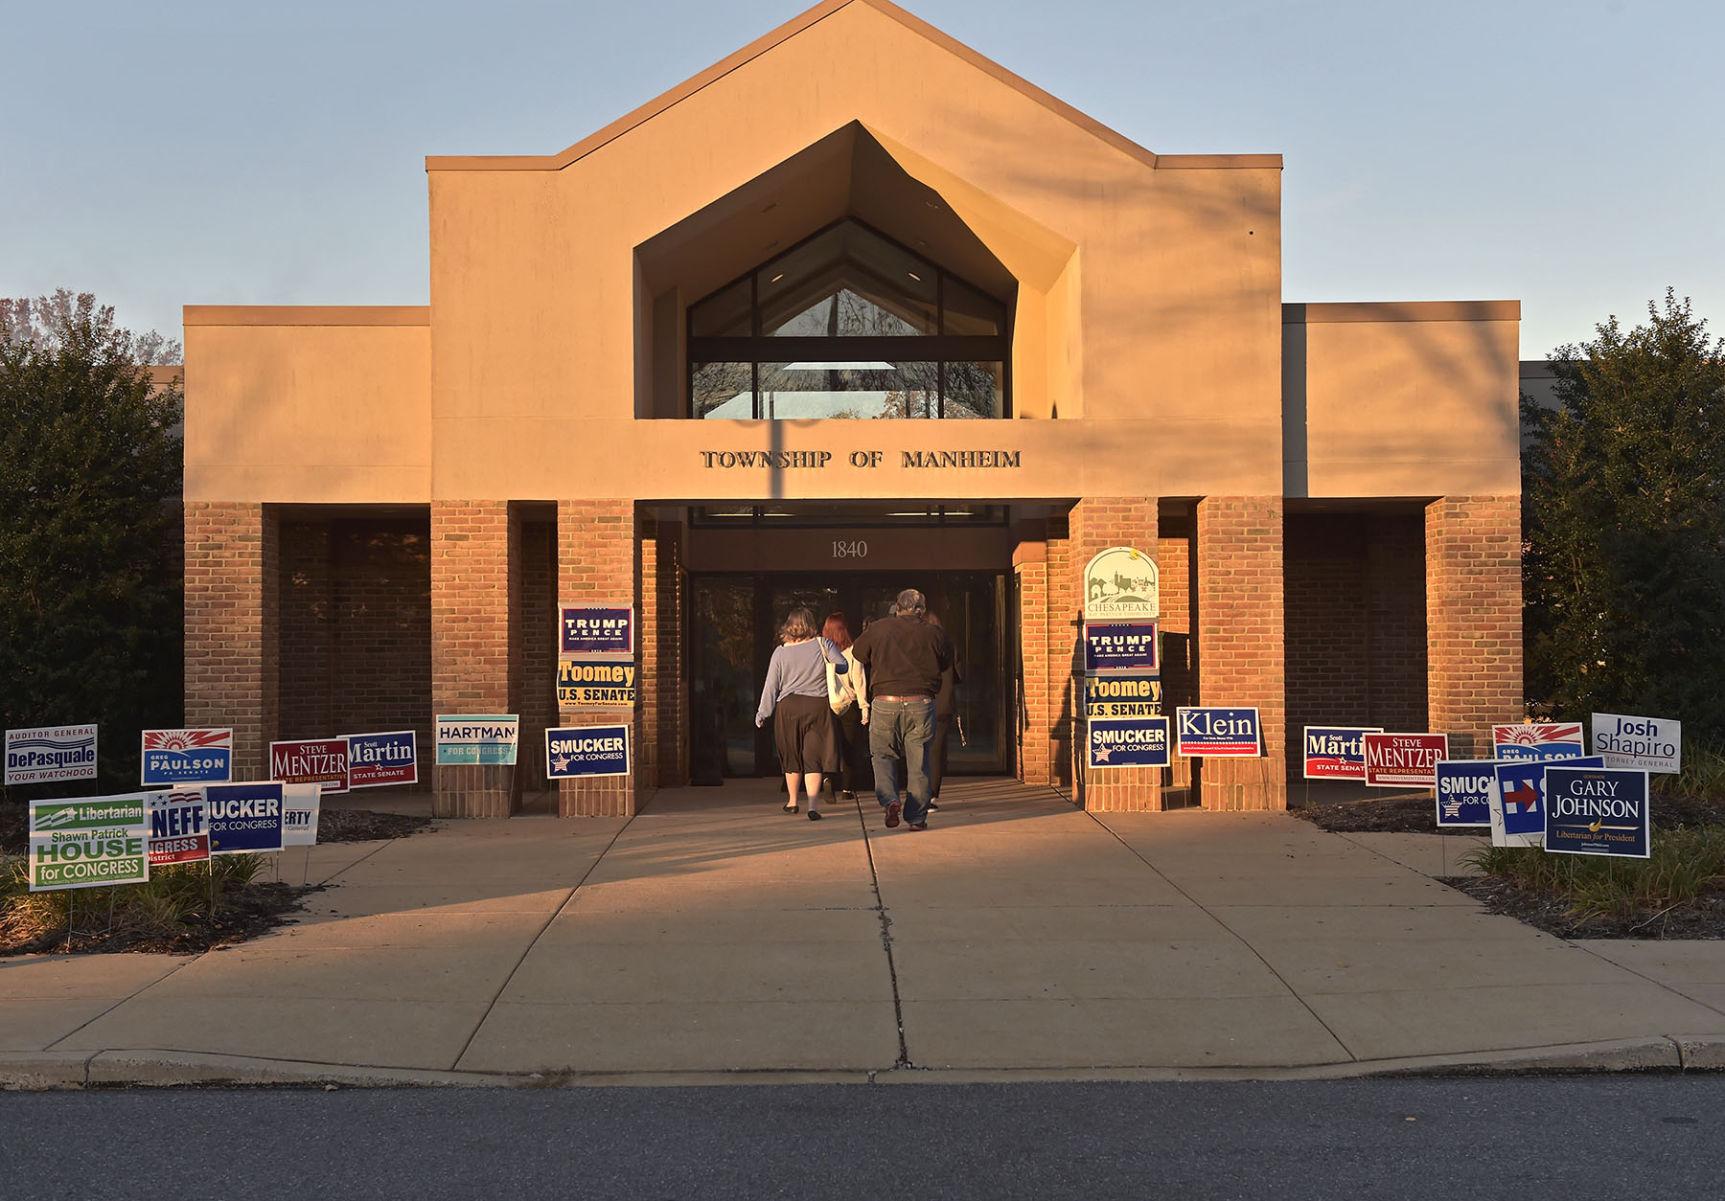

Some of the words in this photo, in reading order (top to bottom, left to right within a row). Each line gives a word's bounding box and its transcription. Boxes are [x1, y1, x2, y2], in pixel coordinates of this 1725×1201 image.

[700, 451, 832, 468] TOWNSHIP
[850, 451, 883, 468] OF
[901, 450, 1022, 468] MANHEIM
[832, 540, 868, 558] 1840
[565, 619, 628, 628] TRUMP
[1089, 635, 1152, 646] TRUMP
[1095, 645, 1146, 653] PENCE
[559, 661, 635, 687] Toomey
[559, 689, 581, 701] U.S.
[584, 688, 636, 701] SENATE
[1086, 677, 1160, 701] Toomey
[1087, 704, 1108, 716] U.S.
[1111, 703, 1161, 716] SENATE
[1180, 712, 1253, 736] Klein
[1615, 718, 1658, 737] Josh
[9, 730, 50, 740] AUDITOR
[54, 728, 94, 737] GENERAL
[440, 726, 515, 739] HARTMAN
[1092, 729, 1165, 744] SMUCKER
[299, 744, 327, 755] STEVE
[550, 737, 624, 754] SMUCKER
[1112, 744, 1126, 752] FOR
[1127, 743, 1165, 752] CONGRESS
[1308, 735, 1364, 755] Marti
[1392, 737, 1423, 748] STEVE
[1596, 732, 1675, 758] Shapiro
[8, 746, 95, 768] DePasquale
[350, 741, 412, 763] Martin
[570, 753, 585, 761] FOR
[585, 752, 624, 761] CONGRESS
[1367, 742, 1443, 768] MENTZER
[150, 758, 224, 770] PAULSON
[273, 751, 347, 777] MENTZER
[8, 772, 36, 781] YOUR
[39, 768, 94, 779] WATCHDOG
[377, 770, 405, 778] SENATE
[1440, 776, 1497, 793] SMUC
[1570, 780, 1619, 796] GARY
[1463, 796, 1479, 805] FOR
[1552, 795, 1639, 819] JOHNSON
[79, 805, 142, 821] Libertarian
[207, 799, 279, 819] UCKER
[151, 805, 203, 839] NEFF
[285, 811, 311, 825] ERTY
[209, 822, 227, 832] FOR
[229, 820, 278, 831] CONGRESS
[51, 832, 88, 843] Shawn
[91, 828, 129, 840] Patrick
[1556, 830, 1592, 840] Libertarian
[1604, 834, 1636, 842] President
[37, 838, 143, 863] HOUSE
[149, 853, 176, 862] istrict
[40, 866, 60, 880] for
[63, 860, 139, 878] CONGRESS
